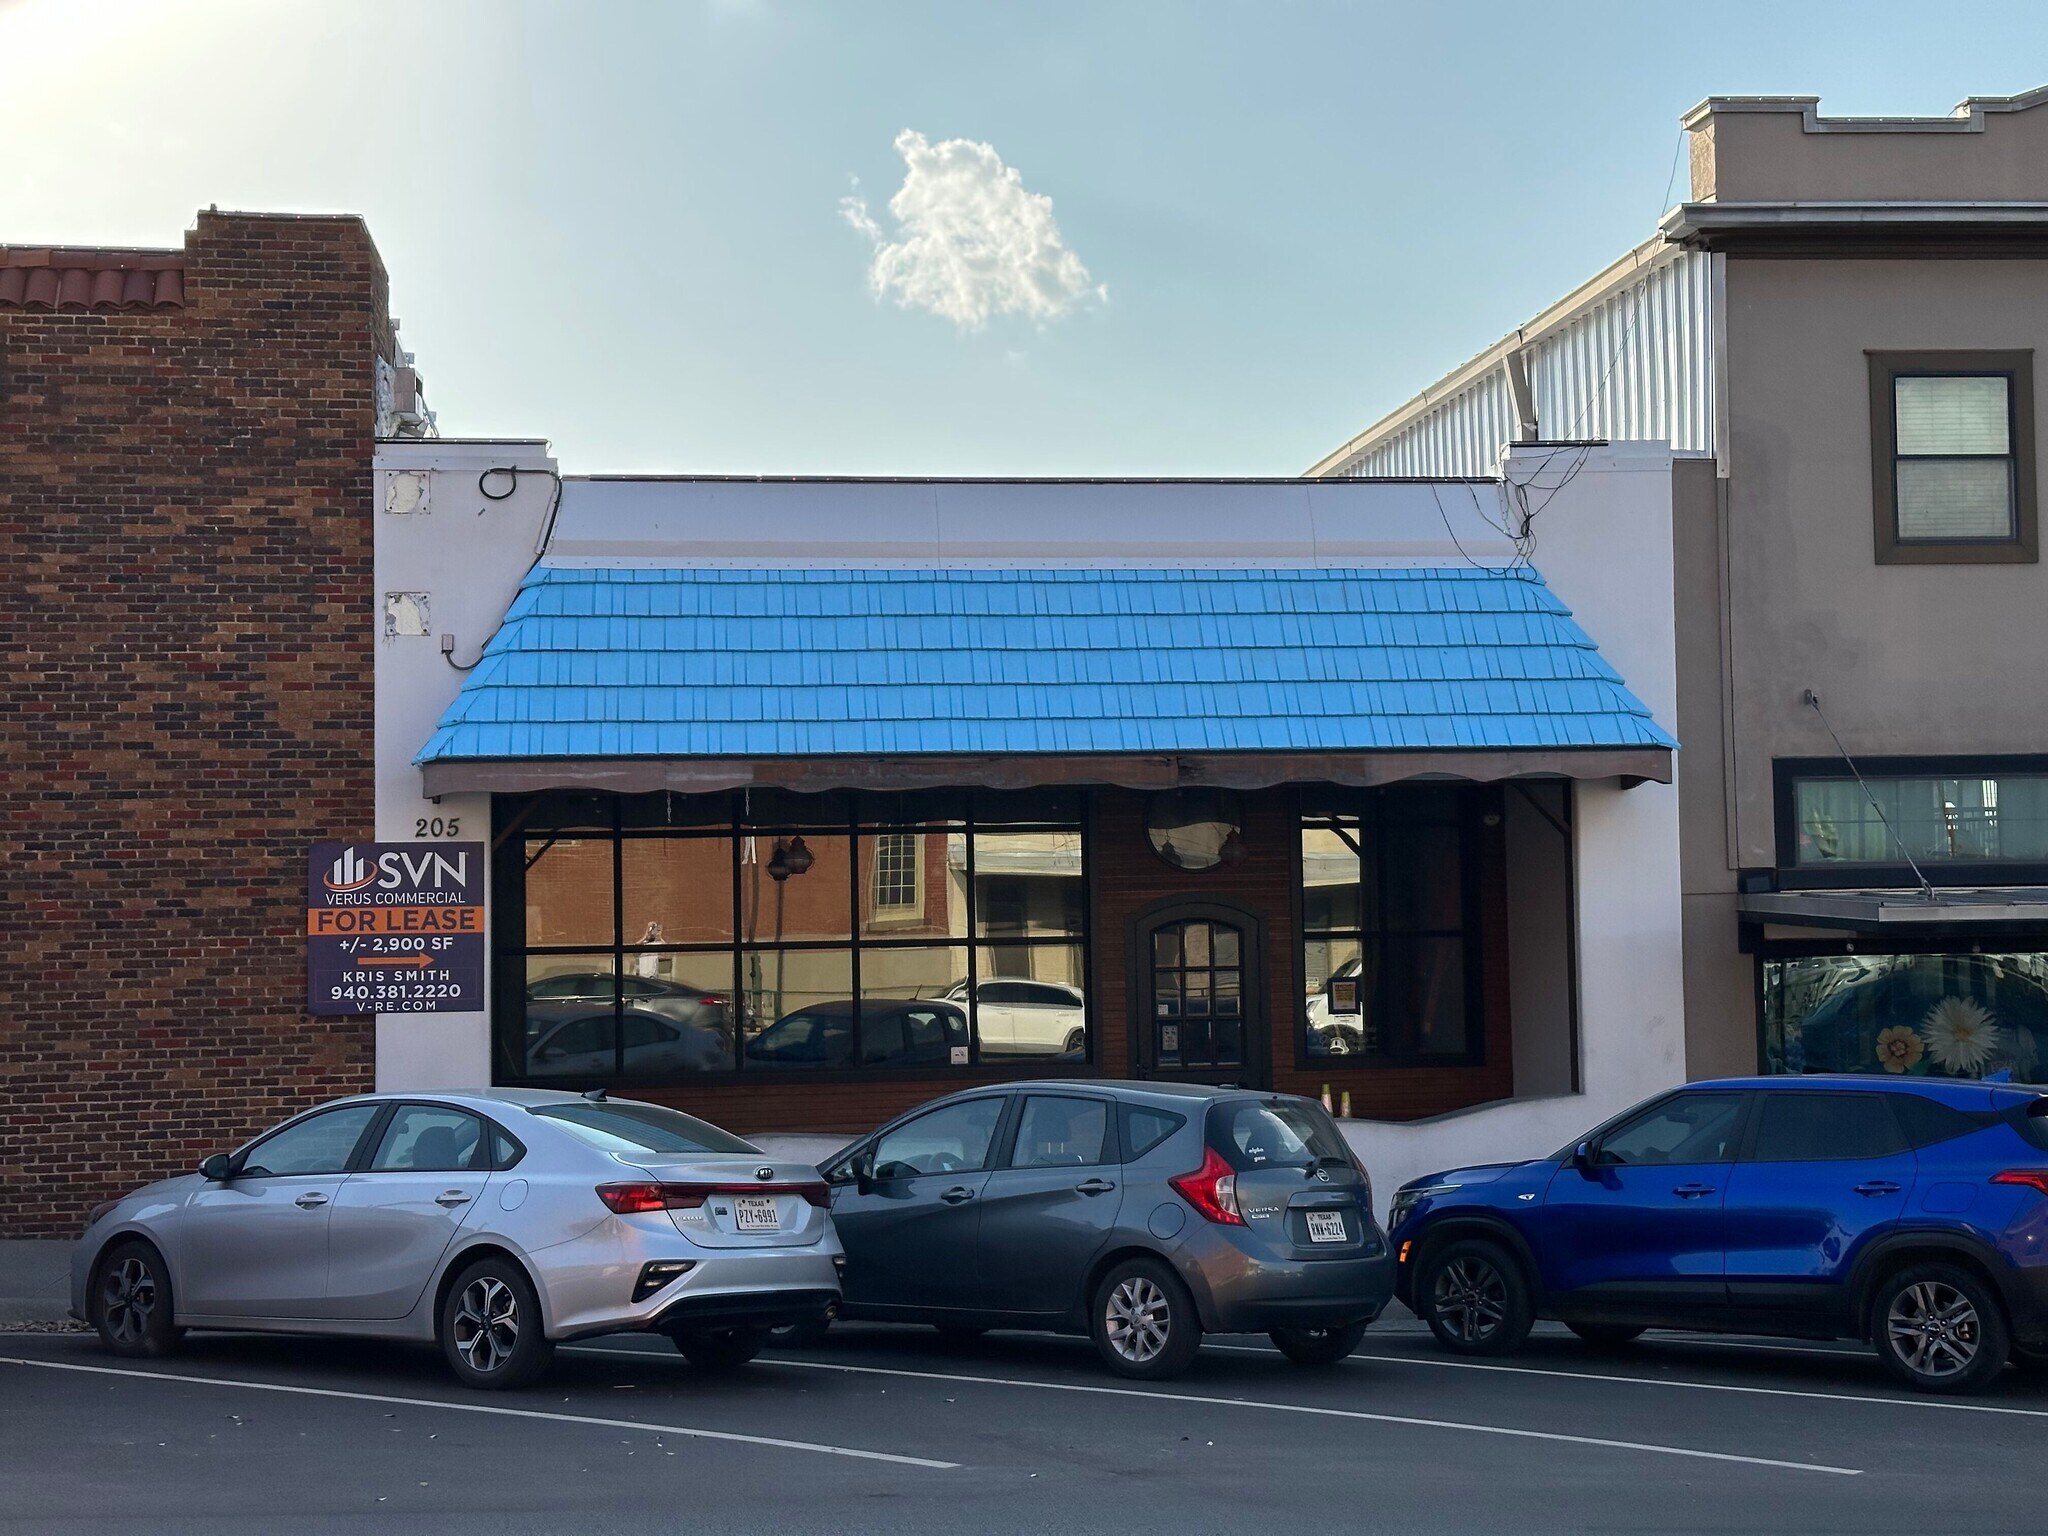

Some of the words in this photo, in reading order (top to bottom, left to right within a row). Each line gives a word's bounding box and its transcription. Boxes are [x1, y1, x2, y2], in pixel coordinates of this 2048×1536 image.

[415, 817, 460, 838] 205
[377, 851, 466, 889] SVN
[325, 893, 371, 905] VERUS
[375, 891, 466, 905] COMMERCIAL
[318, 911, 376, 932] FOR
[386, 909, 475, 931] LEASE
[339, 937, 367, 953] +/-
[372, 937, 425, 953] 2,900
[431, 937, 453, 950] SF
[343, 971, 385, 982] KRIS
[394, 969, 450, 982] SMITH
[331, 984, 461, 1000] 940.381.2220
[356, 1001, 436, 1012] V-RE.COM
